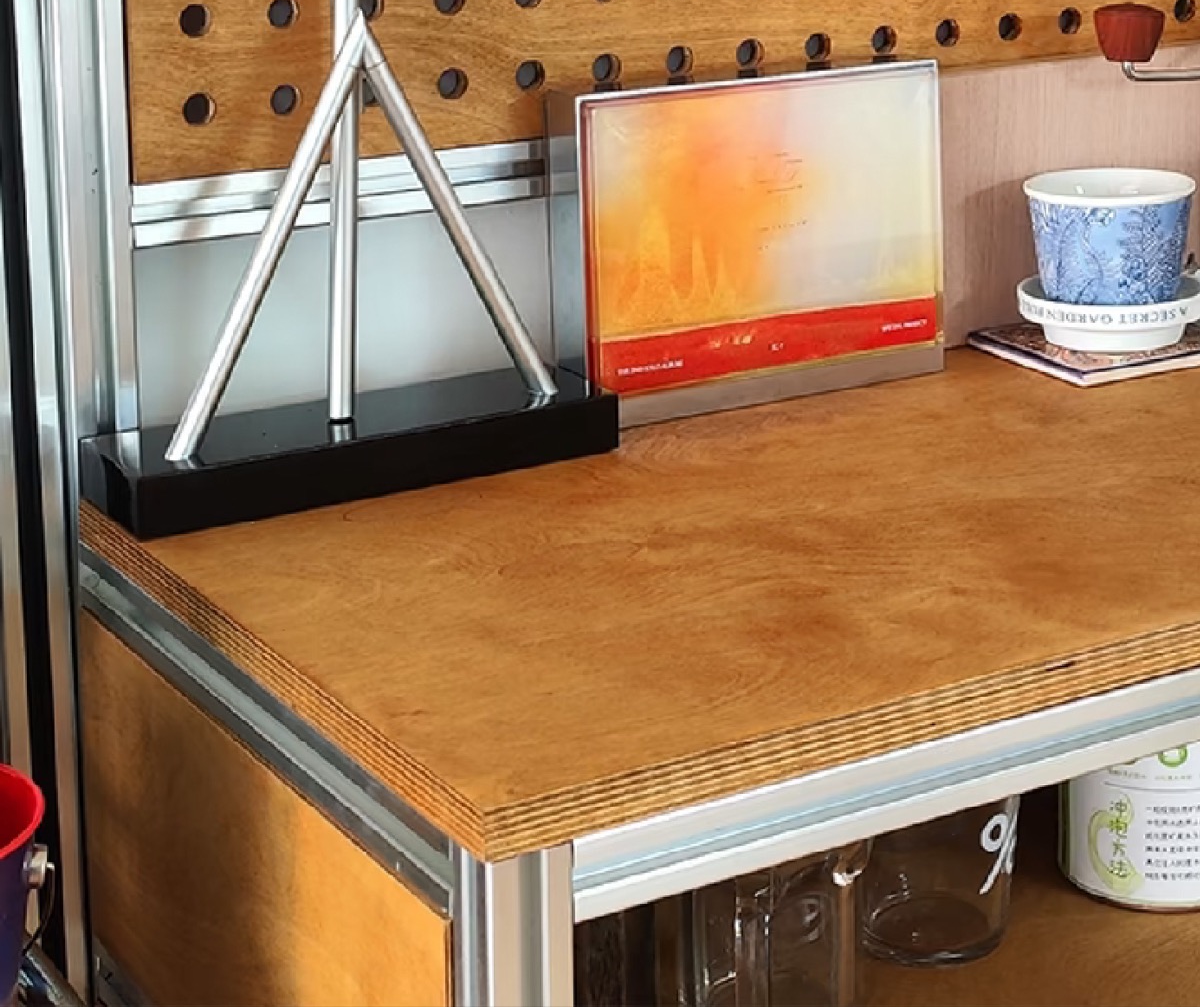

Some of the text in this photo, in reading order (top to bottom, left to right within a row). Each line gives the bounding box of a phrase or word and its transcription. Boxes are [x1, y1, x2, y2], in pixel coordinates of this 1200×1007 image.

[1047, 310, 1114, 325] GARDEN
[1118, 308, 1177, 325] SECRET
[1179, 306, 1189, 316] A
[1108, 798, 1129, 878] 冲泡方法
